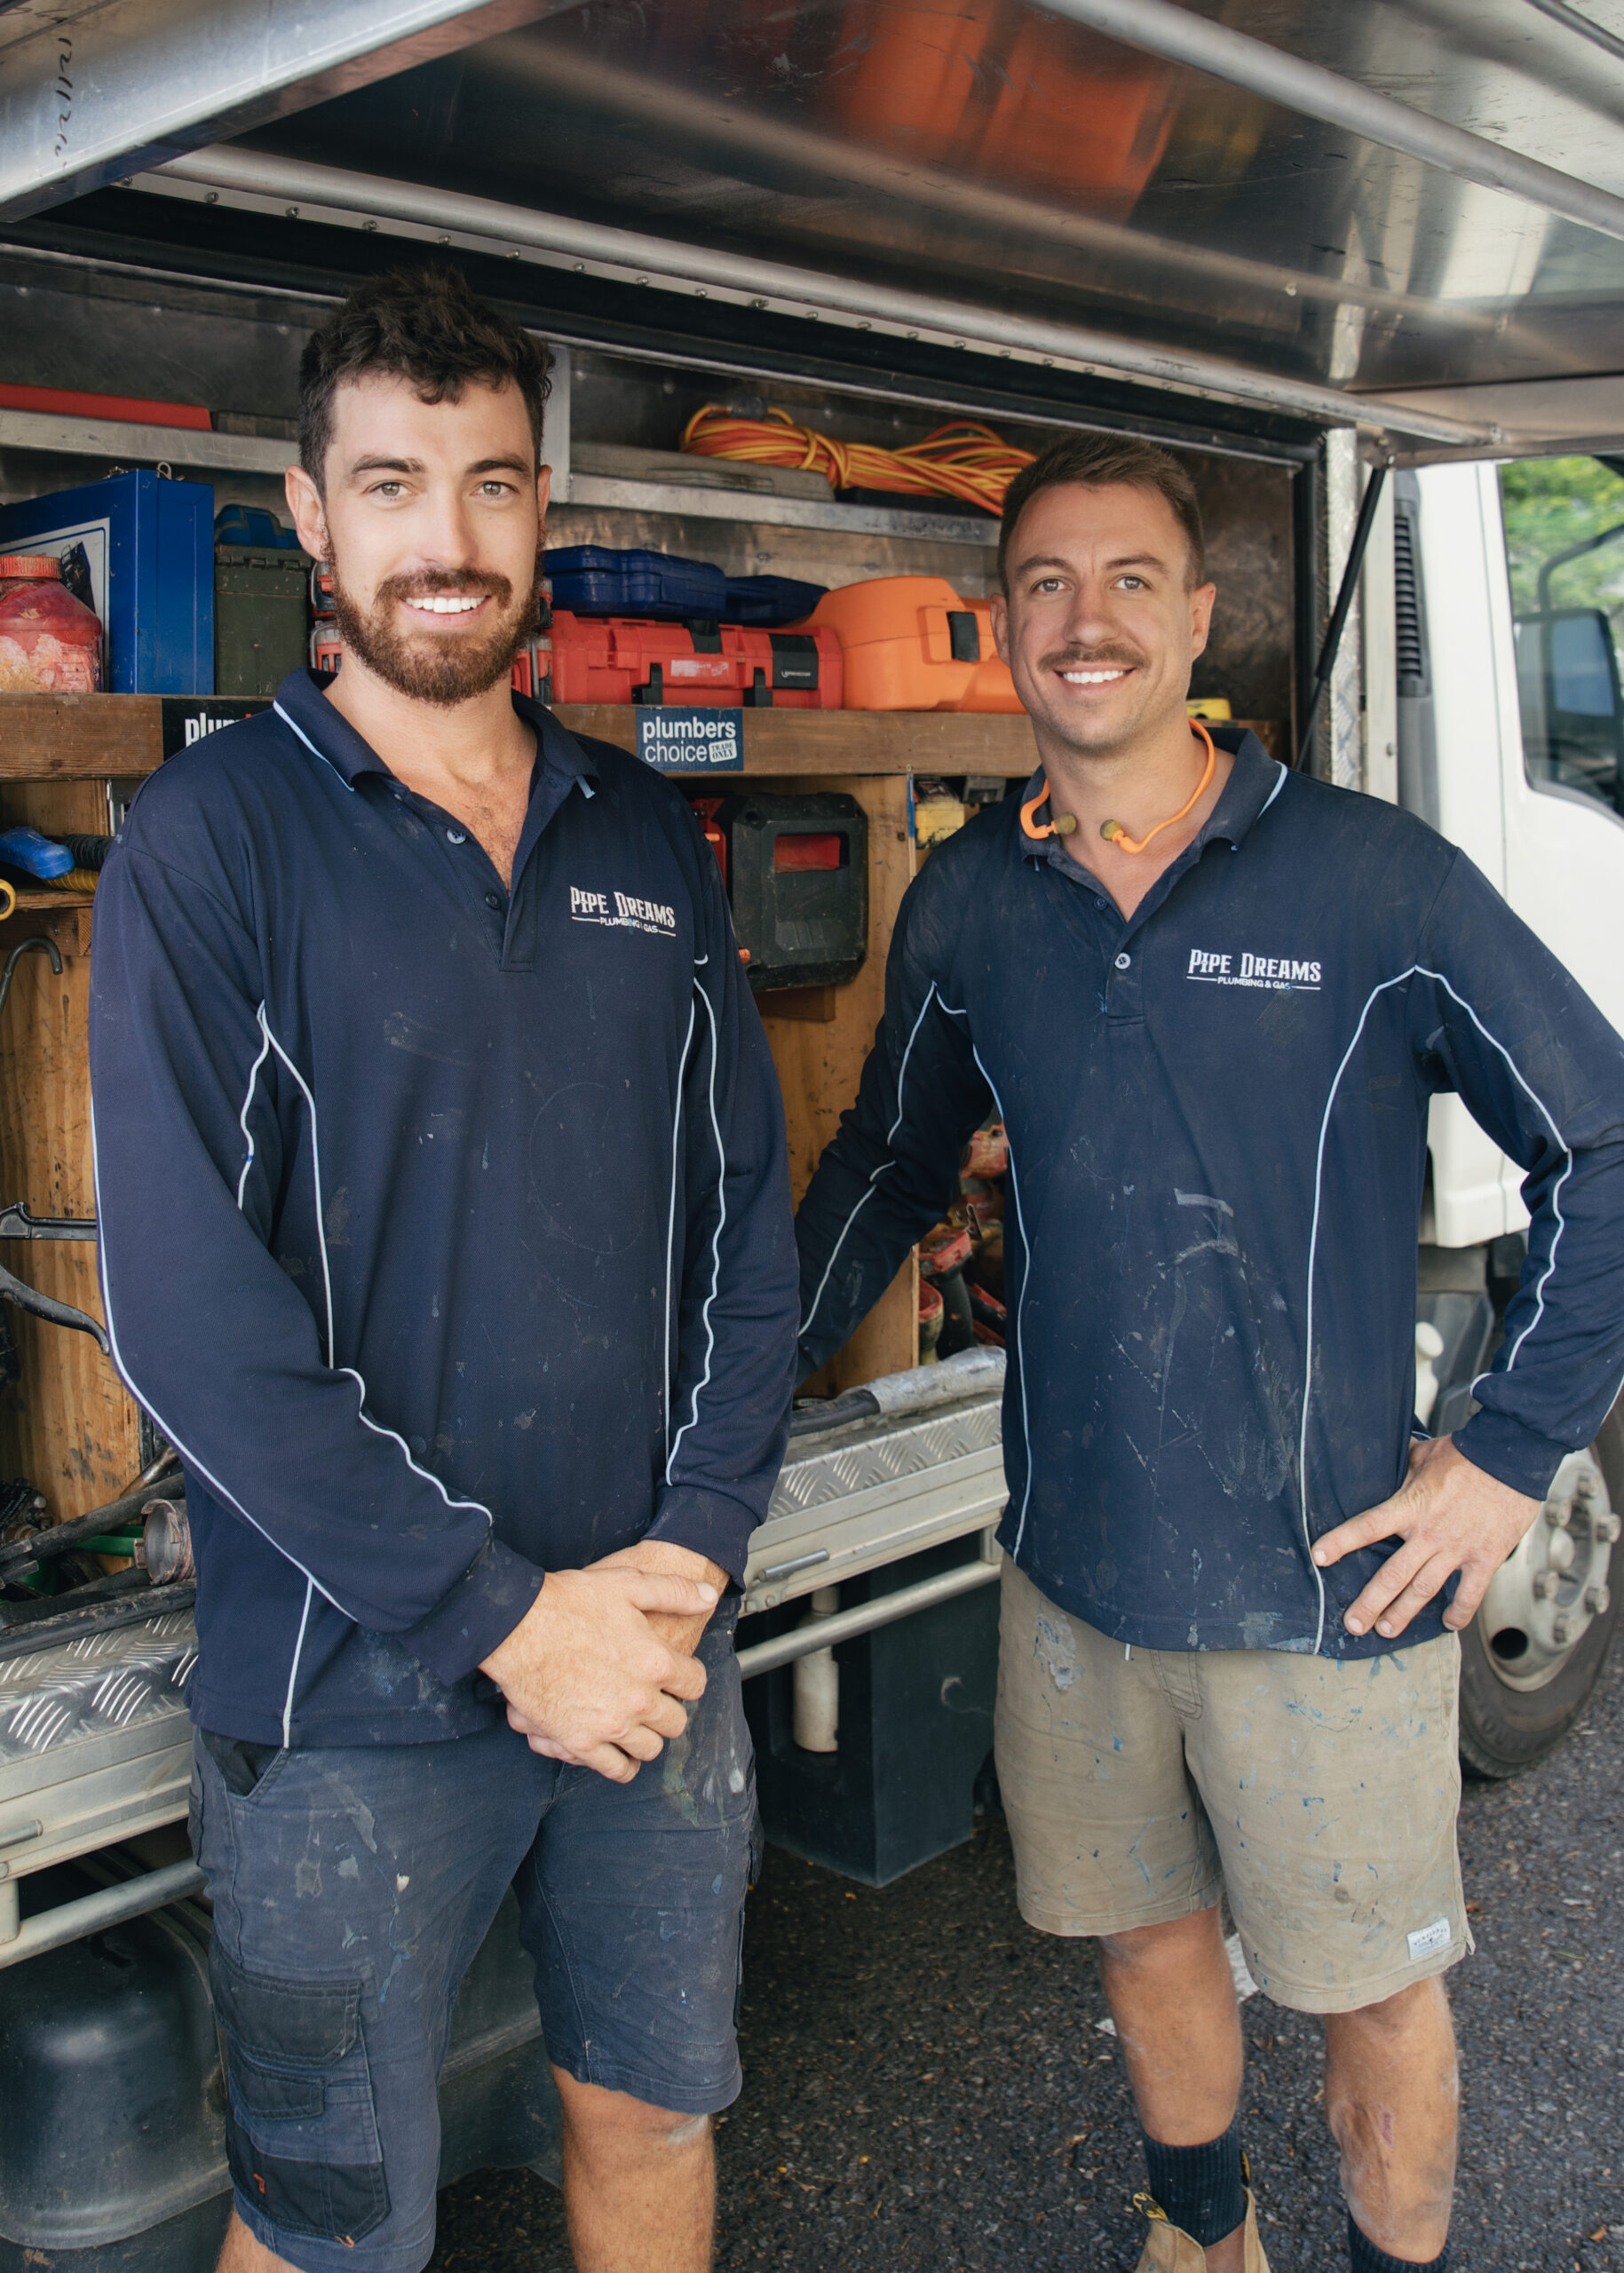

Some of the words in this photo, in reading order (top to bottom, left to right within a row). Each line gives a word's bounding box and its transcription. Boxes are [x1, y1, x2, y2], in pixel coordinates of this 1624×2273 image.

[643, 717, 736, 743] plumbers
[645, 741, 708, 762] choice
[712, 749, 733, 760] ONLY
[570, 886, 609, 915] PIPE
[614, 891, 675, 928] DREAMS
[643, 923, 658, 933] GAS
[1188, 948, 1232, 974] PIPE
[1240, 952, 1321, 982] DREAMS
[1217, 977, 1264, 988] PLUMBING
[1272, 981, 1291, 990] GAS
